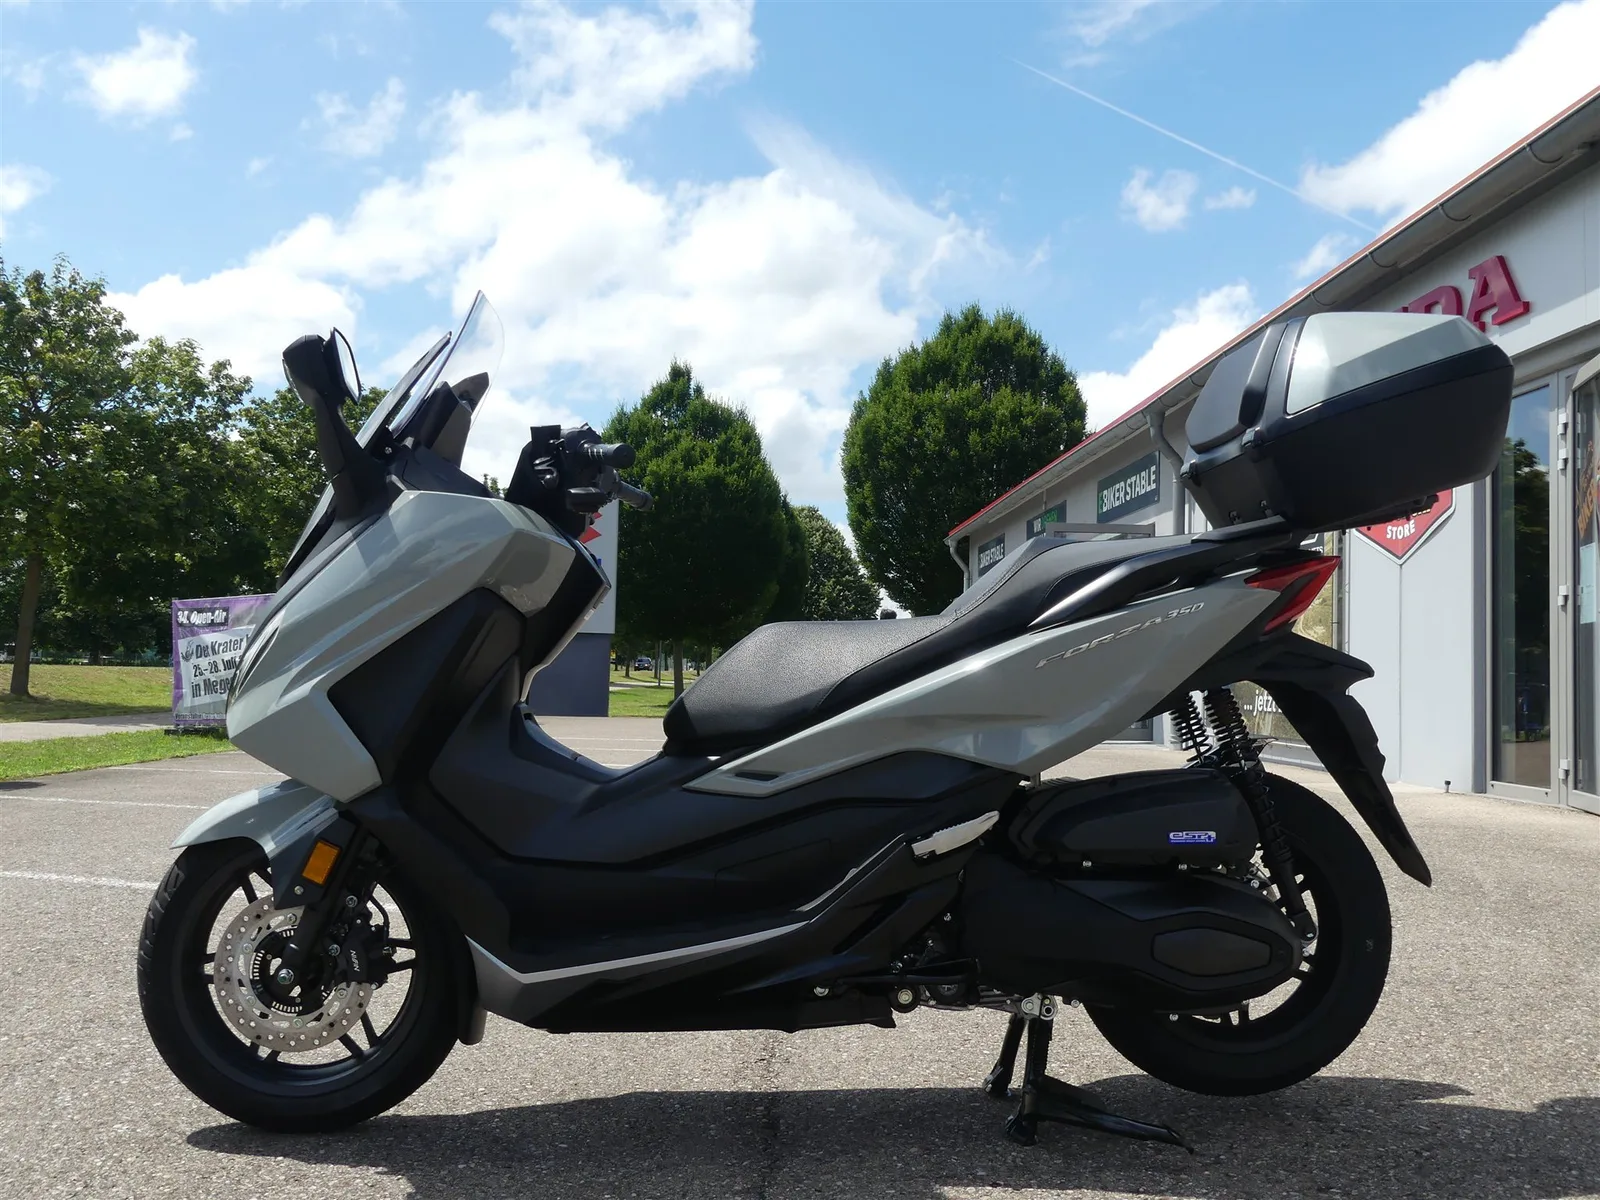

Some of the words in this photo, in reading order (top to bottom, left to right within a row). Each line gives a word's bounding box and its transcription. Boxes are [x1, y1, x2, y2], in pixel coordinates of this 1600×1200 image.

[1126, 464, 1157, 501] STABLE
[1386, 520, 1416, 540] STORE
[190, 609, 227, 625] Open-Air
[1035, 616, 1163, 668] FORZA
[1164, 602, 1205, 621] 350
[210, 637, 244, 656] Krater
[222, 656, 237, 672] Juli
[191, 682, 202, 699] in
[203, 676, 232, 696] Mege
